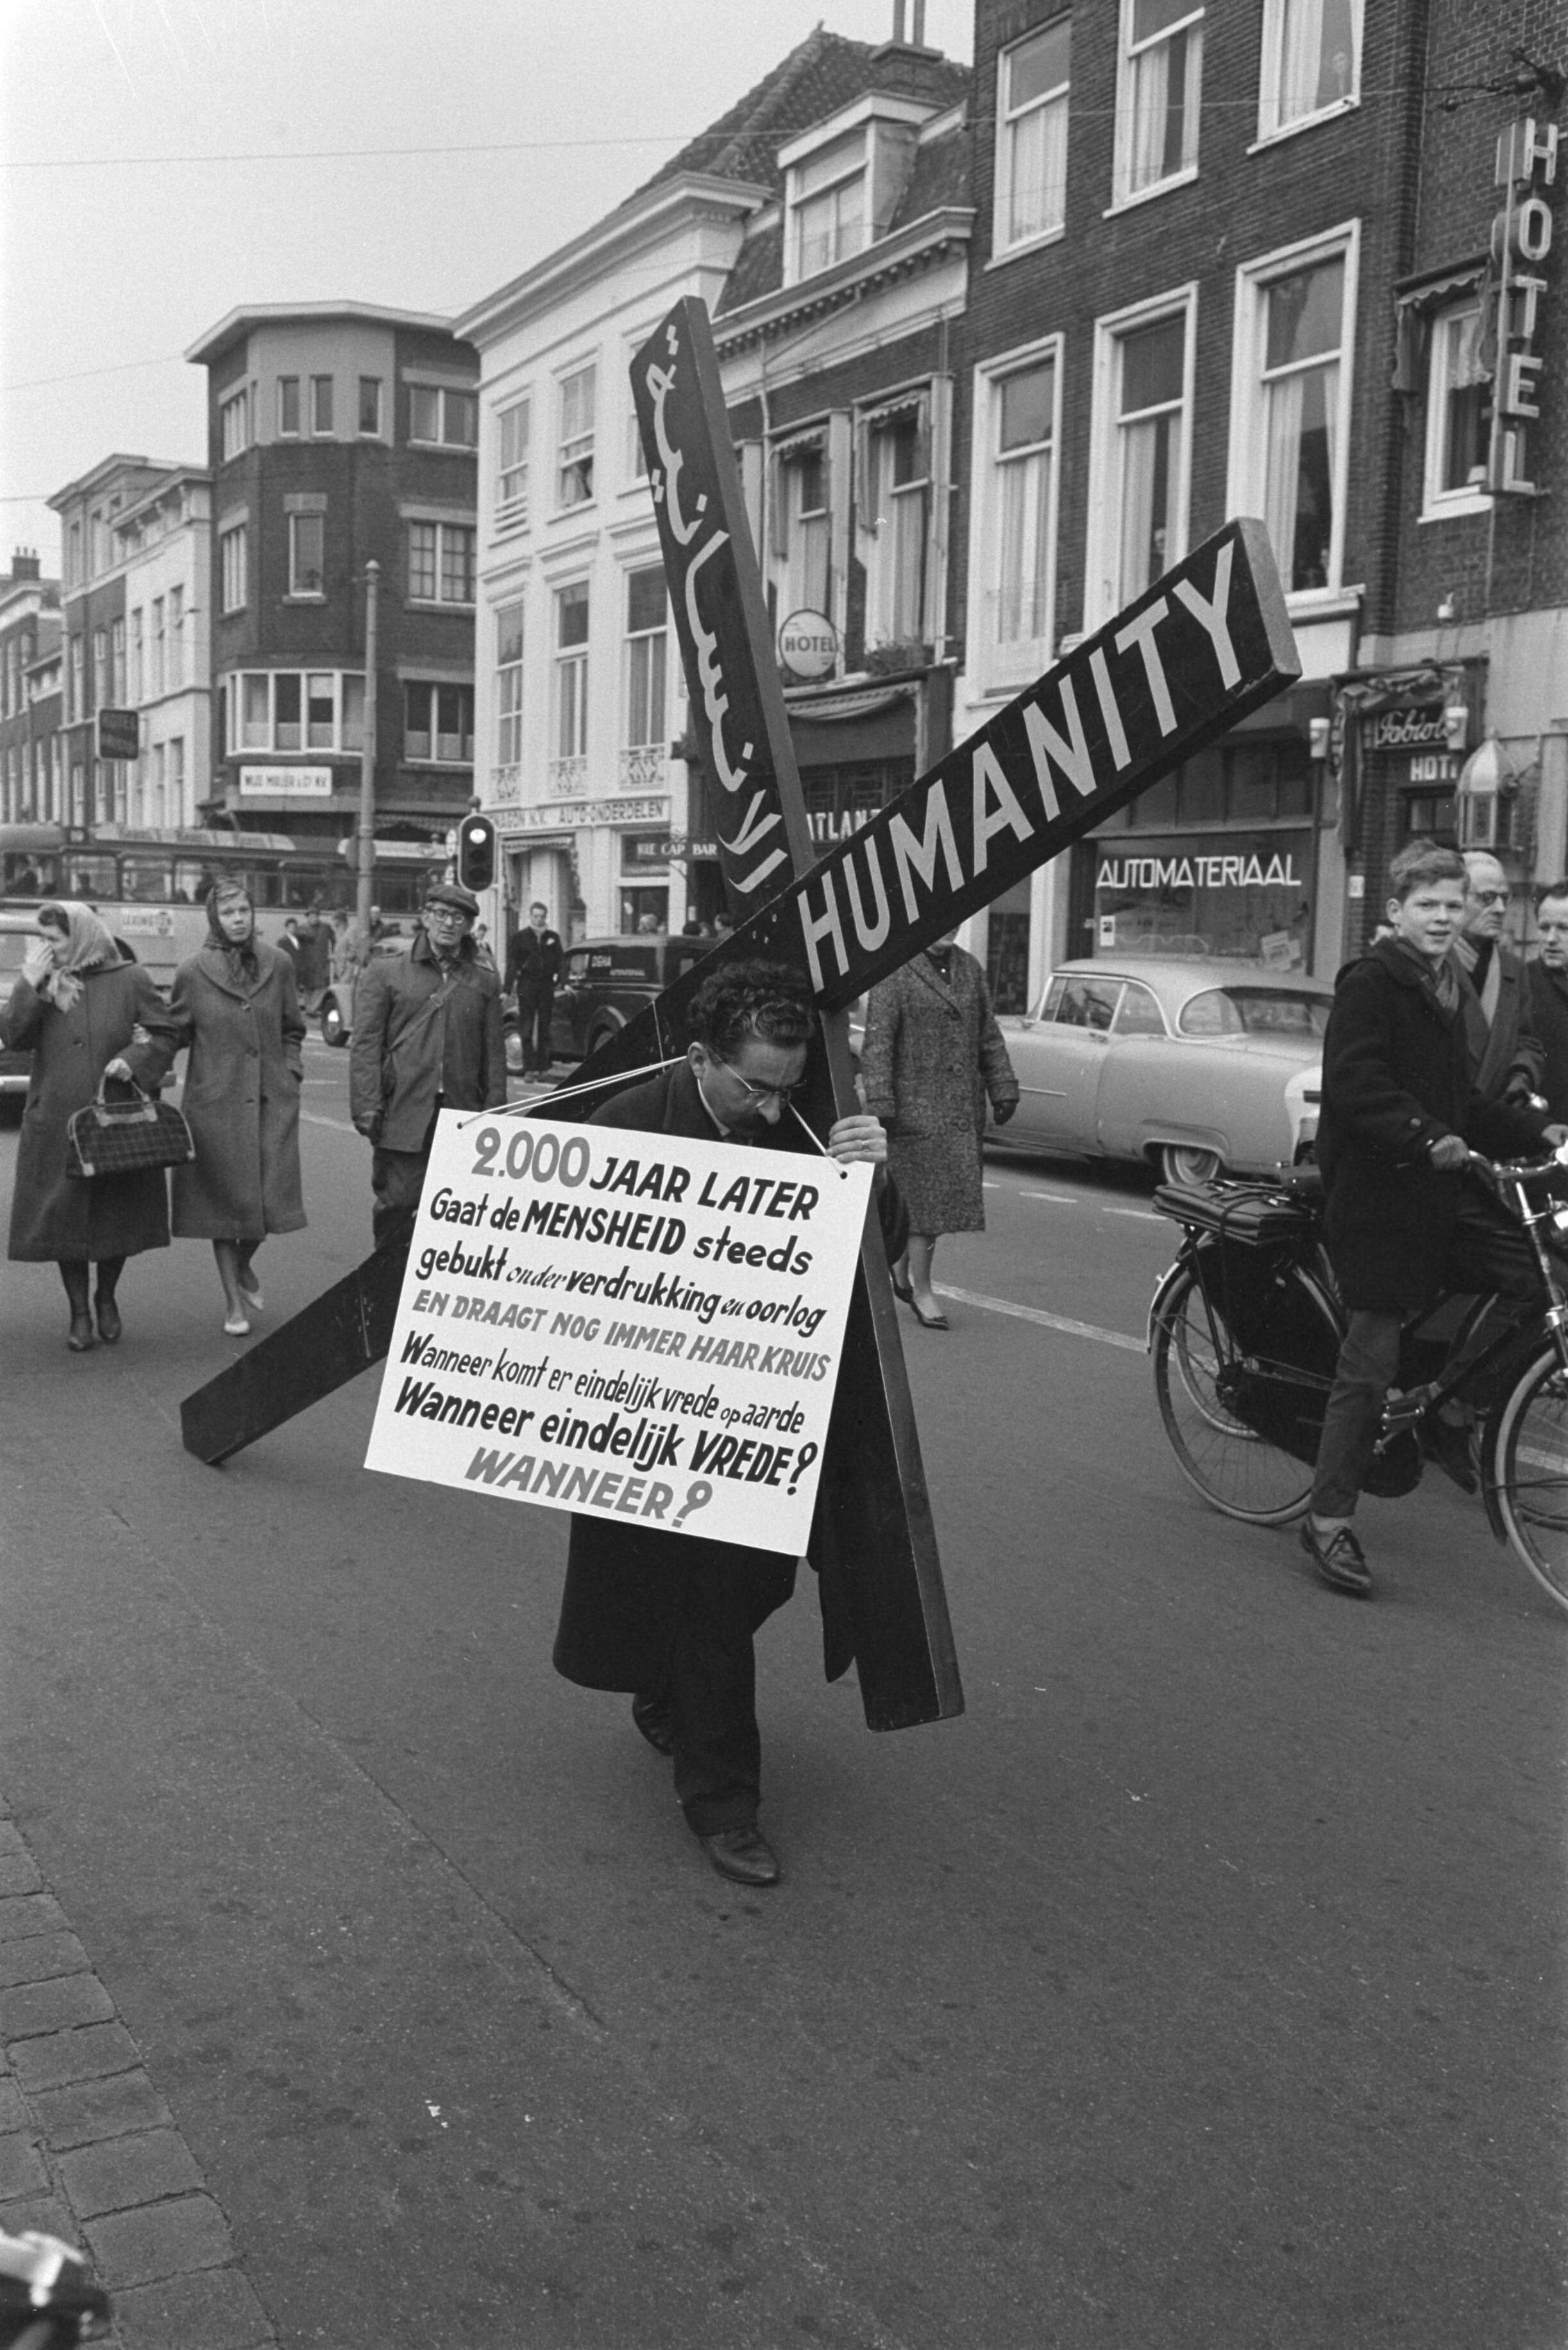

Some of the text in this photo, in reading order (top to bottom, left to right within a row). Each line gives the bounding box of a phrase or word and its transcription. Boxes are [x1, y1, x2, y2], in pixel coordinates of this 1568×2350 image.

[1501, 117, 1558, 495] HOTEL
[784, 636, 836, 653] HOTEL
[797, 537, 1243, 994] HUMANITY
[1376, 708, 1449, 744] Fabiol
[559, 801, 664, 824] AUTO-ONDERDELEN
[692, 842, 718, 856] BAR
[1095, 852, 1302, 888] AUTOMATERIAAL
[471, 1127, 819, 1221] 2.000 JAAR LATER
[430, 1187, 813, 1276] Gaat de MENSHEID steeds
[415, 1240, 828, 1339] gebukt onder verdrukking en oorlog
[412, 1289, 832, 1382] EN DRAAGT NOG IMMER HAAR KRUIS
[400, 1330, 805, 1434] Wanneer komt er eindelijk vrede op aarde
[394, 1376, 818, 1496] Wanneer eindelijk VREDE?
[464, 1446, 712, 1526] WANNEER?
